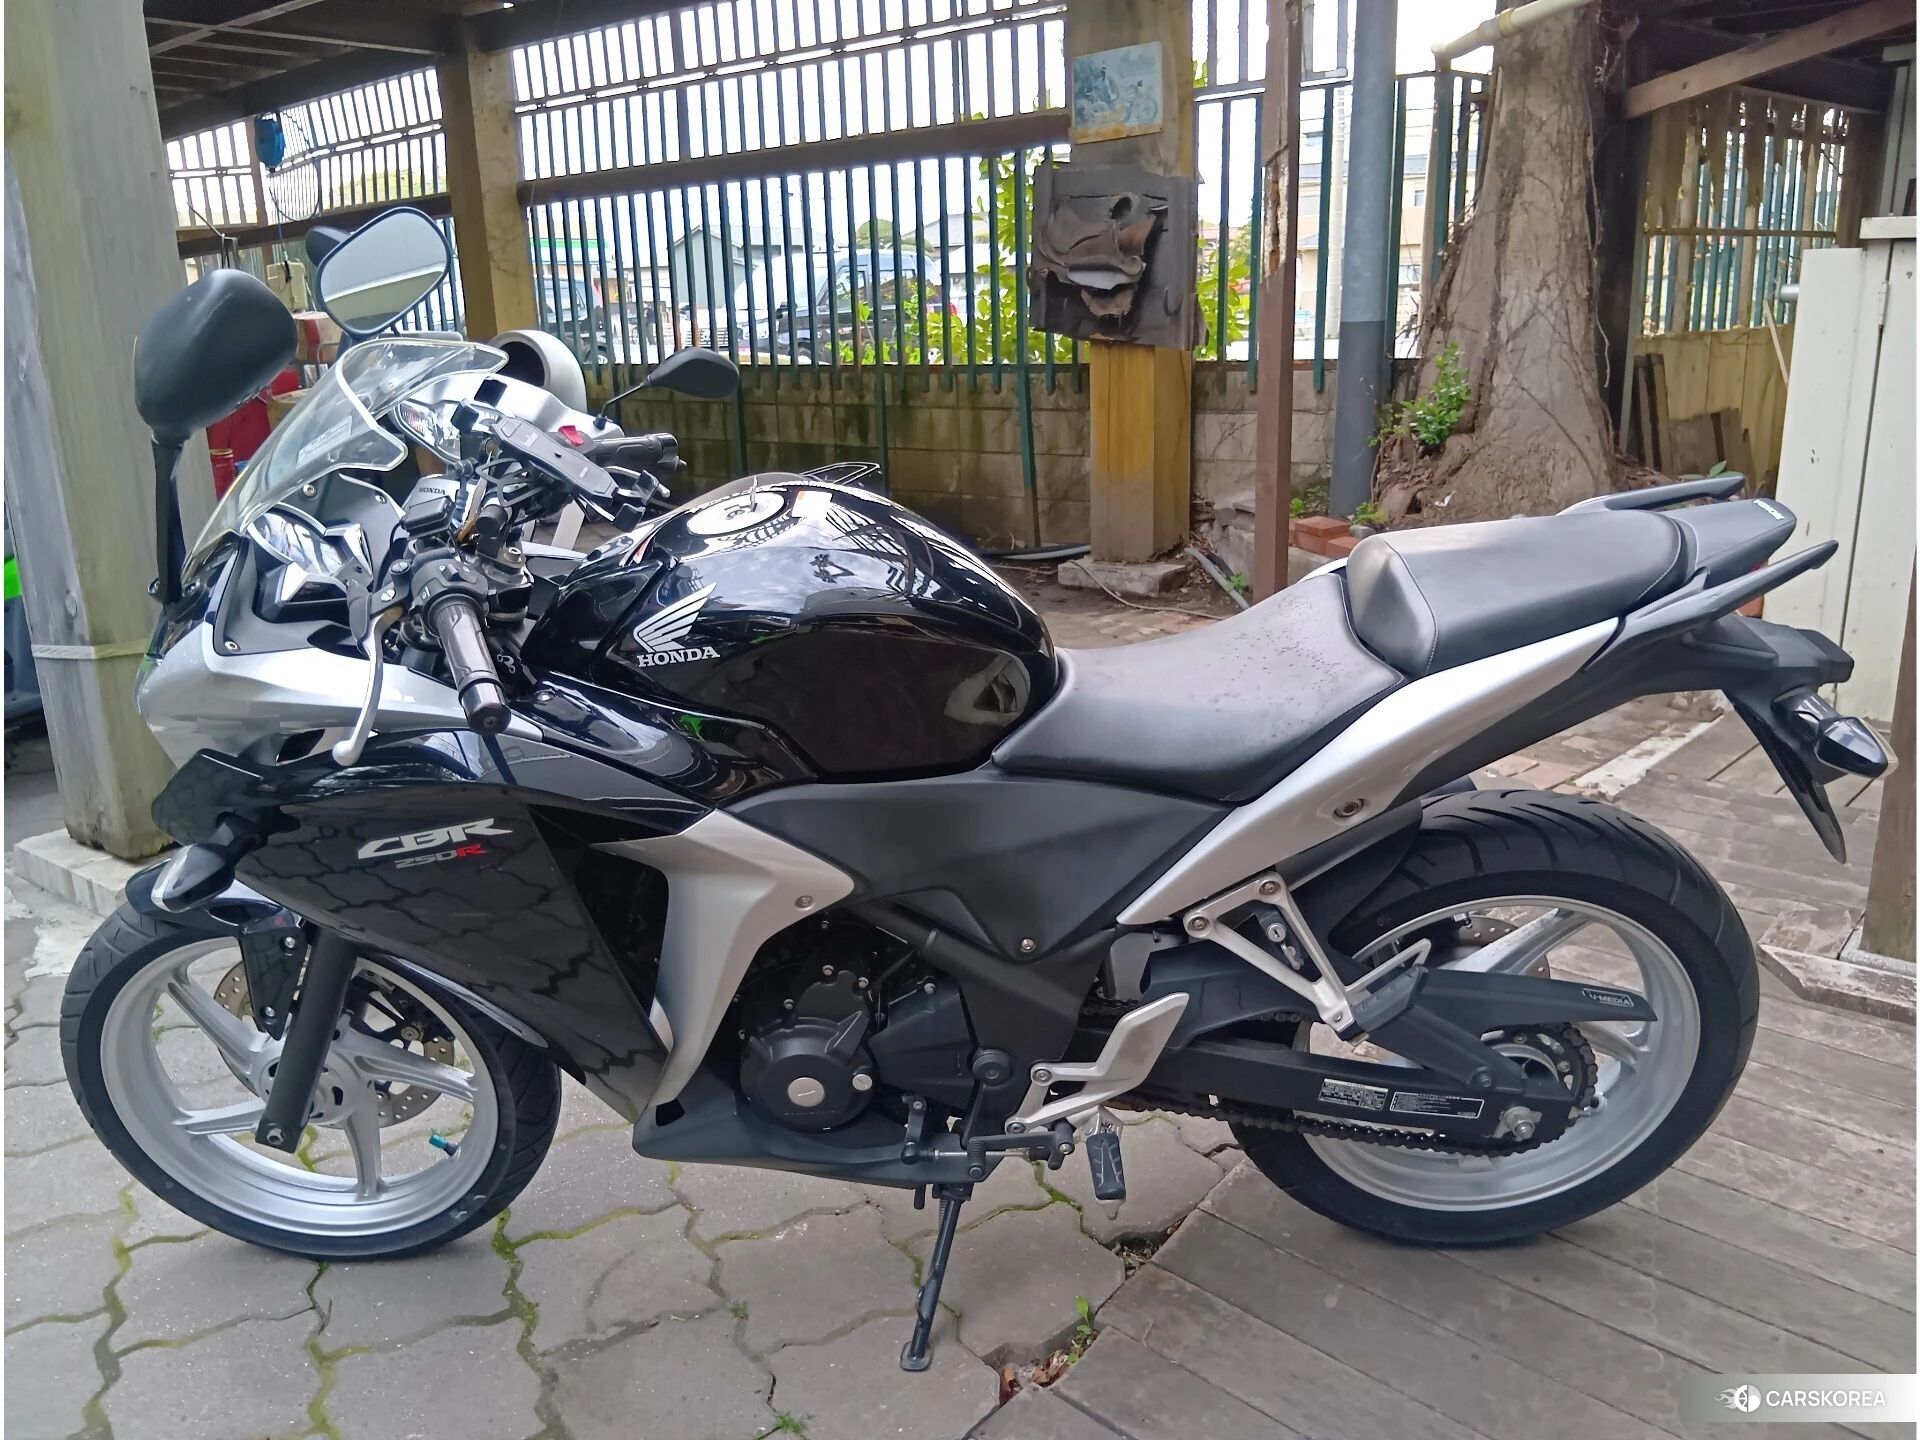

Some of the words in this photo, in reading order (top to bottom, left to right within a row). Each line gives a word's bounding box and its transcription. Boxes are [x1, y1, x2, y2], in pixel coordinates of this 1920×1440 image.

[418, 487, 446, 496] HONDA
[636, 645, 721, 668] HONDA
[358, 817, 514, 860] CBR
[394, 843, 488, 869] 250R
